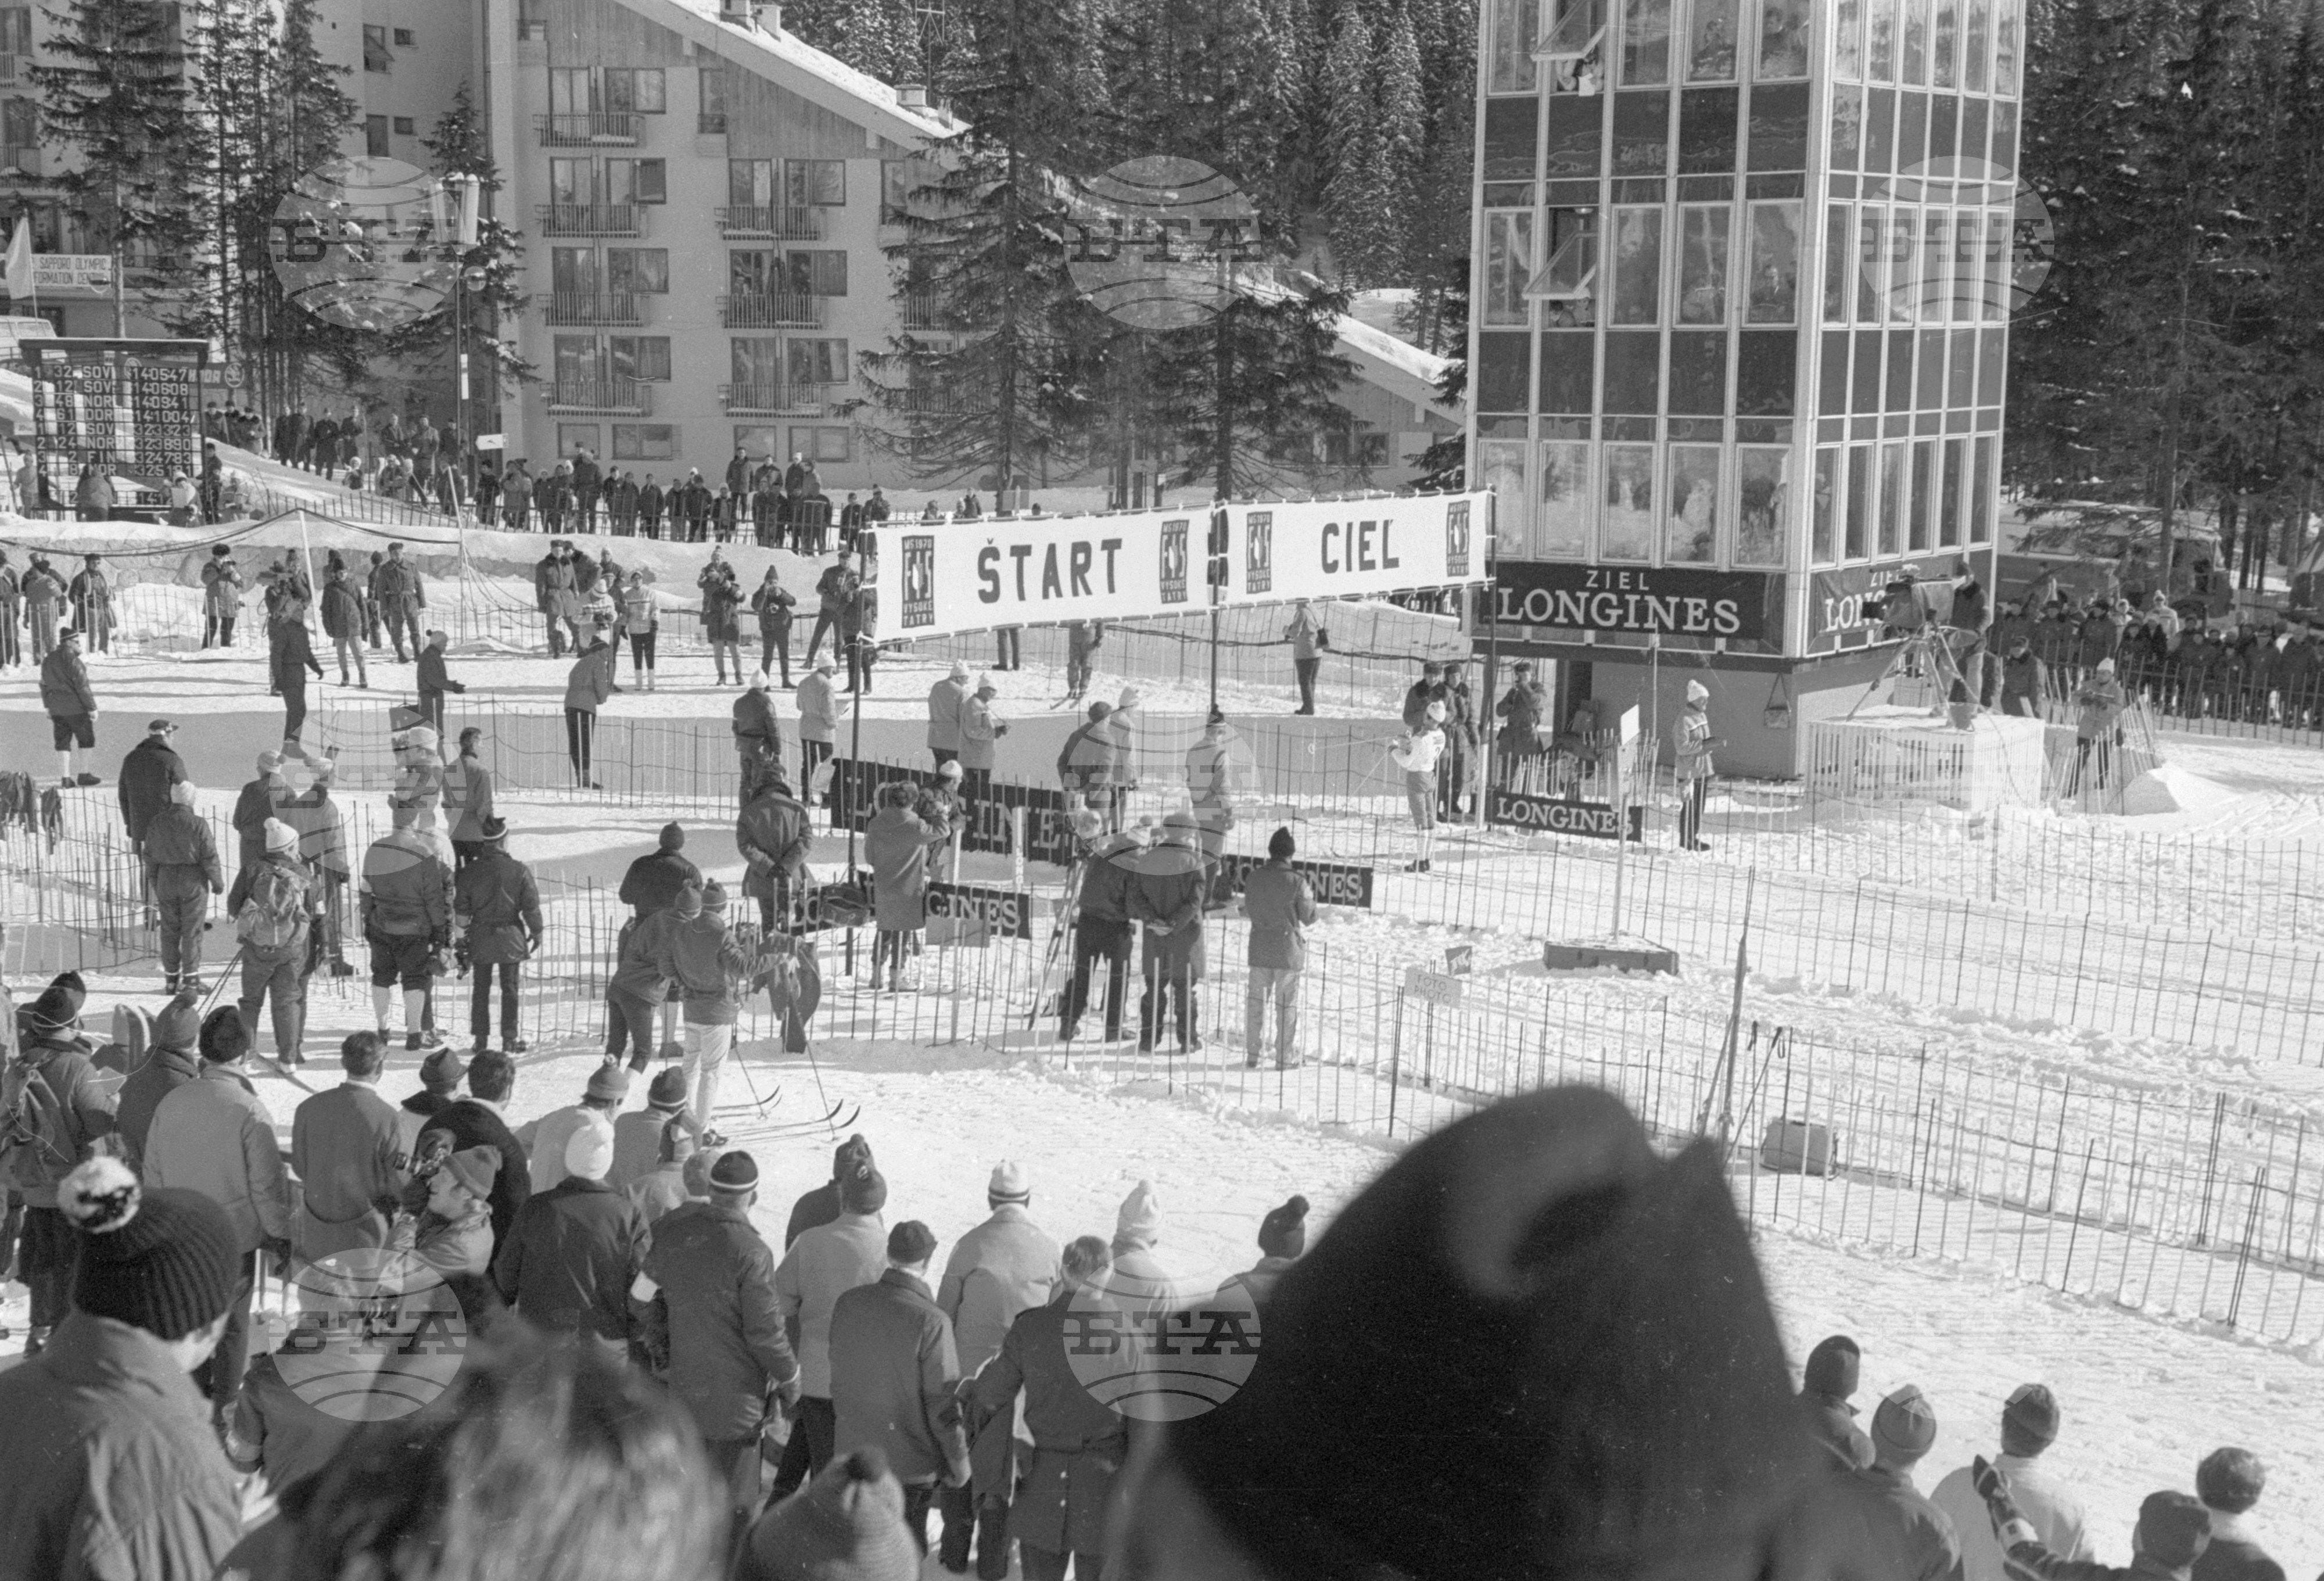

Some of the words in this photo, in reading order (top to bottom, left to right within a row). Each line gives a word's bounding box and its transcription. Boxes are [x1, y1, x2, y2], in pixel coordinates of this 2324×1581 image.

[39, 257, 71, 270] SAPPORO
[75, 258, 107, 271] OLYMPIC
[34, 271, 73, 285] FORMATION
[35, 366, 41, 378] 1
[54, 365, 72, 378] 32
[83, 365, 110, 379] SOV
[34, 380, 42, 393] 2
[56, 380, 73, 393] 12
[84, 380, 111, 393] SOV
[35, 395, 43, 407] 3
[56, 395, 74, 407] 48
[84, 395, 113, 407] NOR
[36, 408, 44, 421] 4
[56, 408, 73, 420] 61
[85, 408, 113, 421] DDR
[38, 423, 44, 435] 1
[60, 423, 76, 435] 12
[87, 423, 114, 435] SOV
[37, 436, 46, 449] 2
[58, 436, 76, 449] 24
[87, 437, 115, 449] NOR
[38, 450, 46, 463] 3
[68, 451, 77, 463] 2
[87, 451, 116, 463] FIN
[39, 465, 48, 476] 4
[70, 464, 78, 475] 8
[88, 464, 116, 475] NOR
[70, 492, 78, 503] 2
[1321, 519, 1400, 574] CIEĽ
[977, 537, 1123, 604] ŠTART
[1585, 570, 1649, 591] ZIEL
[1497, 587, 1741, 633] LONGINES
[903, 614, 933, 626] TATRY
[1413, 985, 1451, 1004] PHOTO
